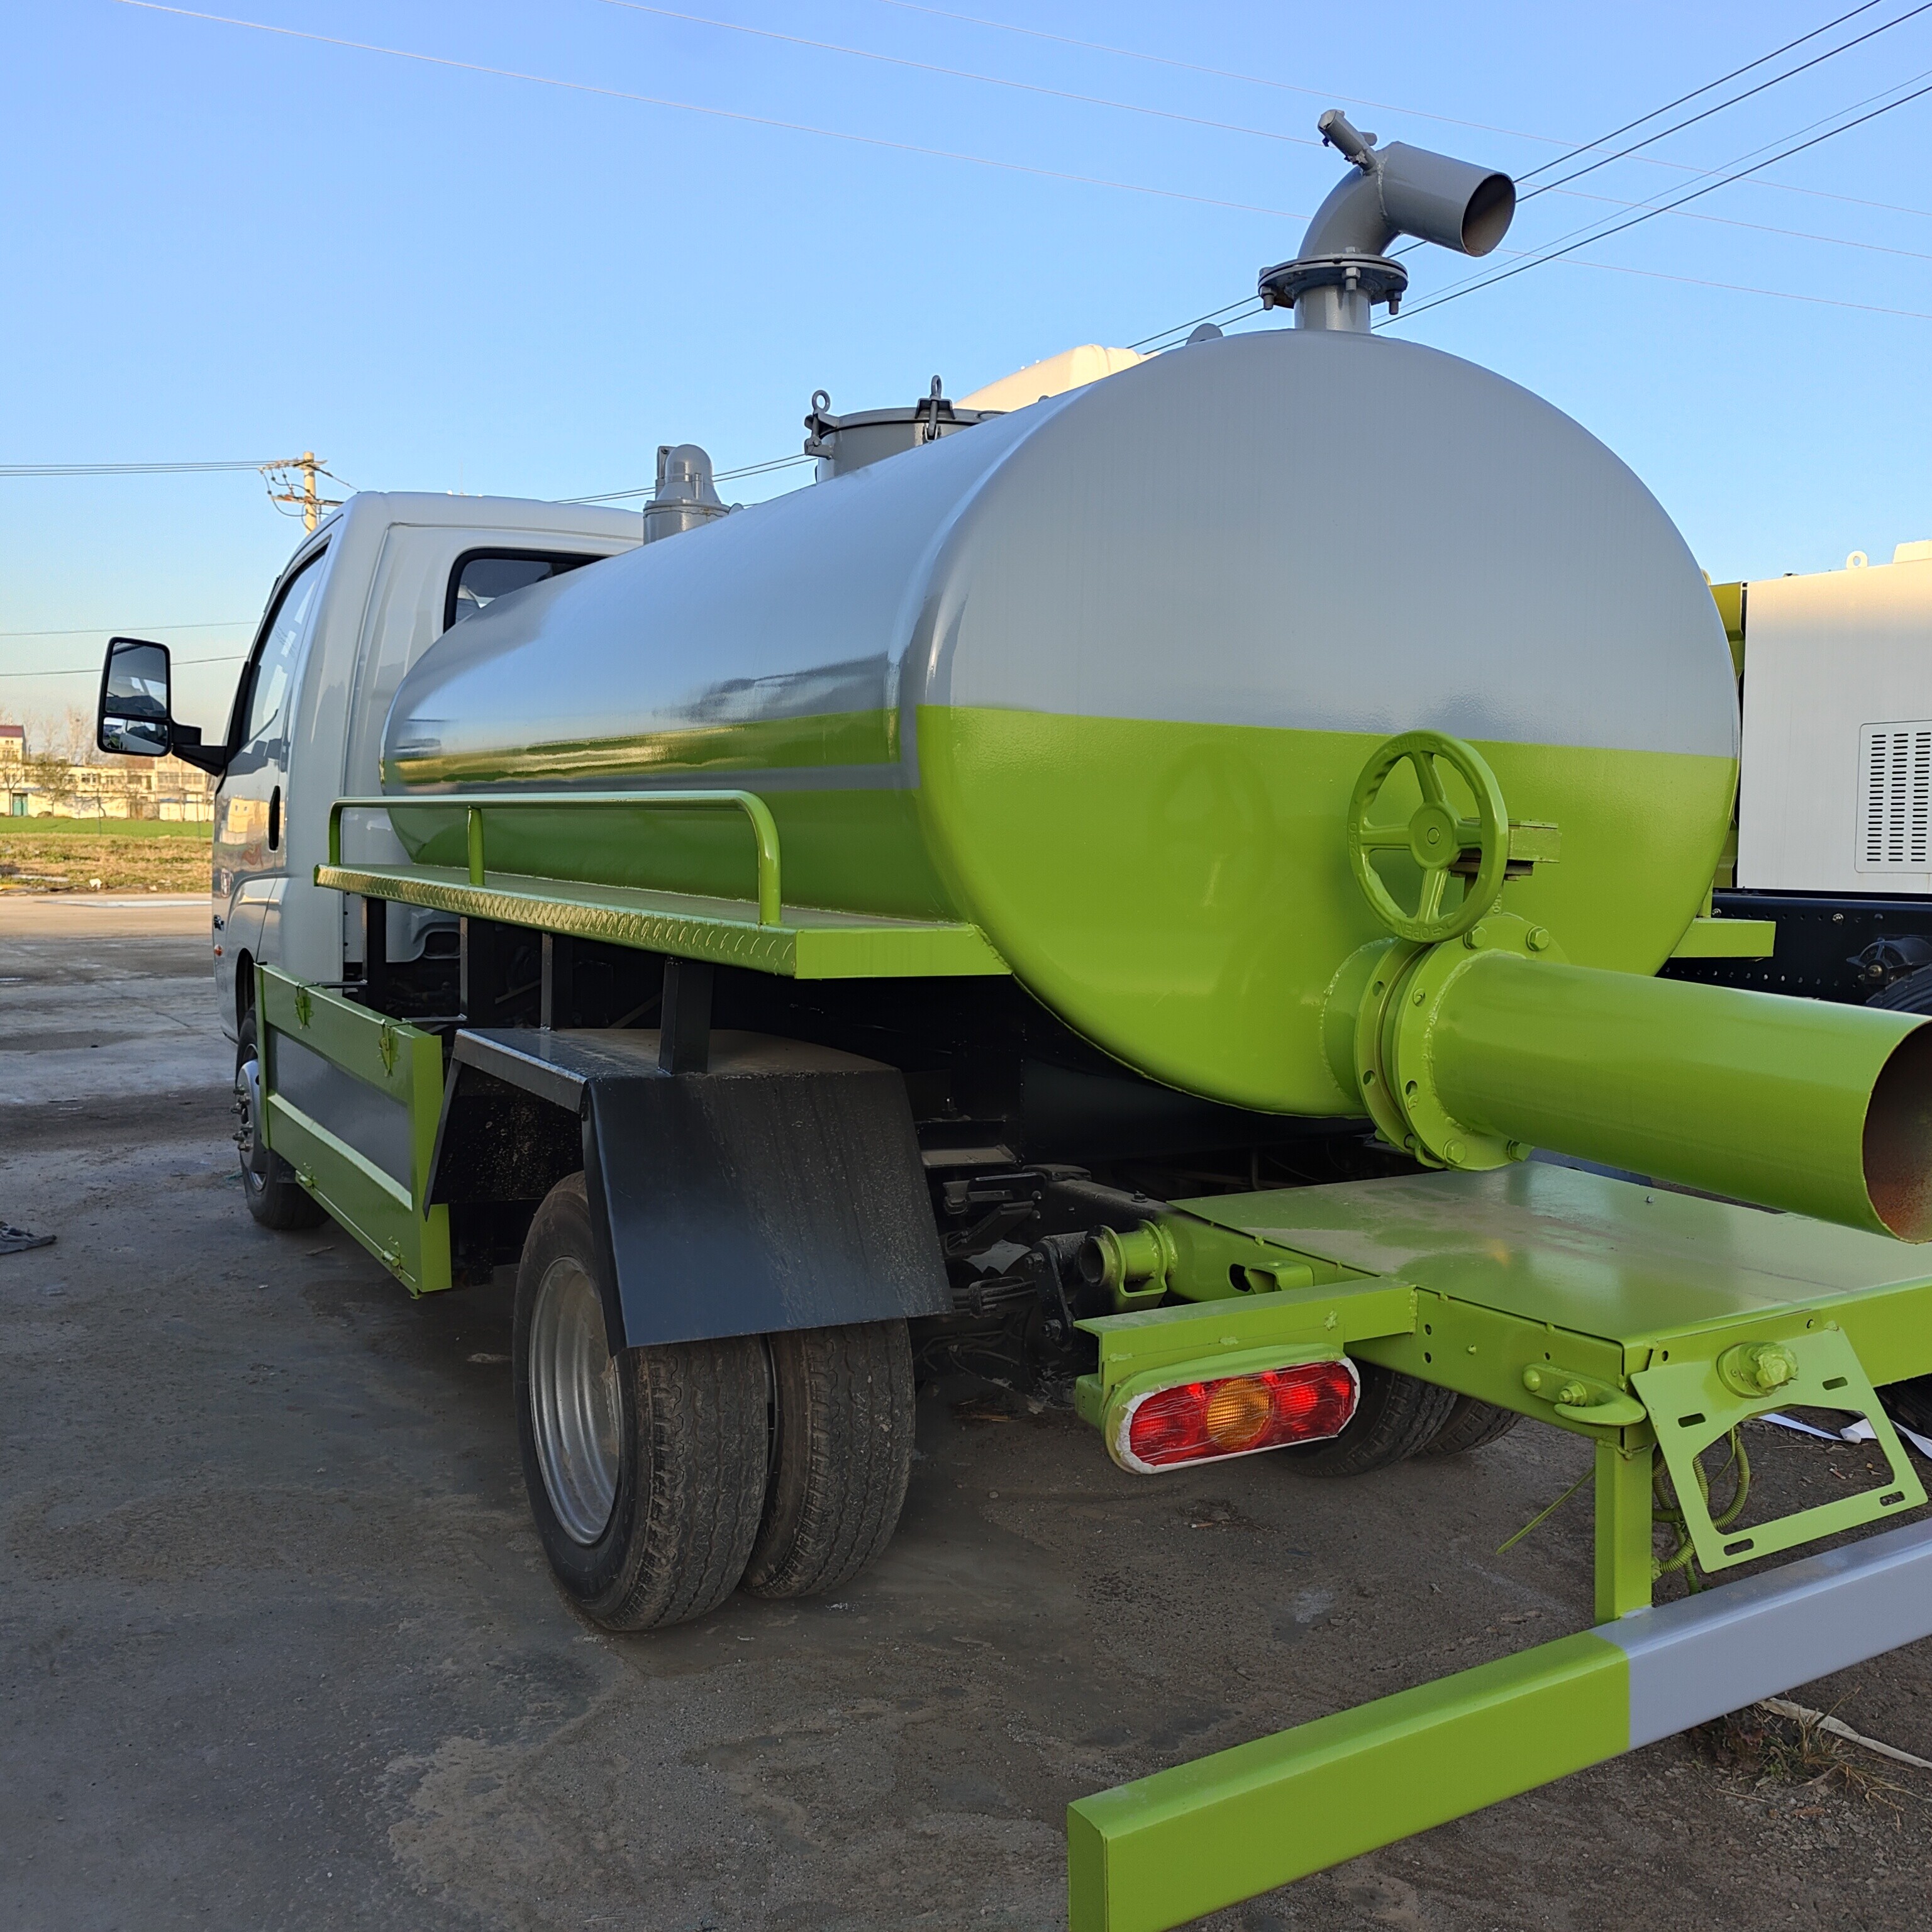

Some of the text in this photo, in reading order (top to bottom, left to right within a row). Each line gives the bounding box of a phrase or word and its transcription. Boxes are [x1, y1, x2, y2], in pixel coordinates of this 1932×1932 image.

[1391, 736, 1423, 753] SHUT
[1348, 822, 1360, 857] 250
[1396, 921, 1430, 940] OPEN
